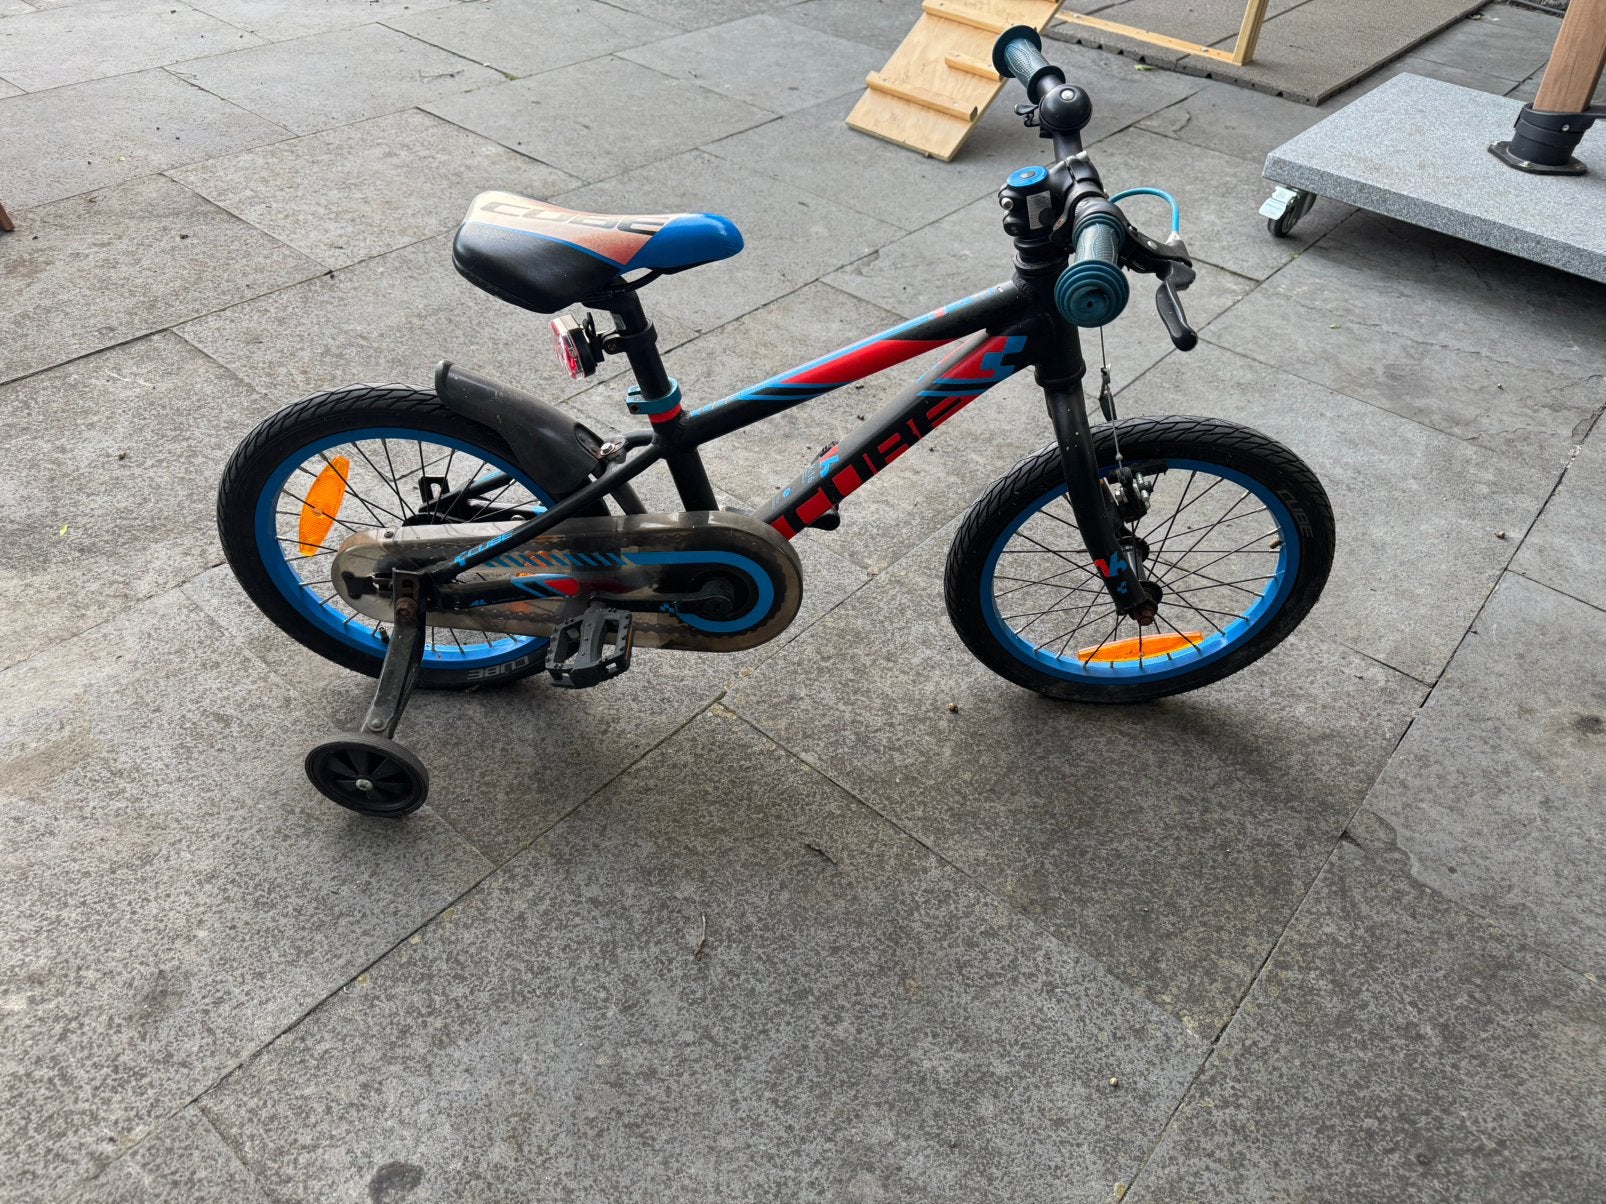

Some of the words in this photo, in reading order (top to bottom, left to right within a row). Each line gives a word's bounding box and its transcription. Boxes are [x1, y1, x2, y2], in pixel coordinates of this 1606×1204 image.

[481, 201, 671, 236] CUBE
[782, 392, 970, 534] CUBE
[1277, 488, 1314, 539] CUBE
[467, 530, 513, 557] CUBE
[466, 657, 529, 681] CUBE
